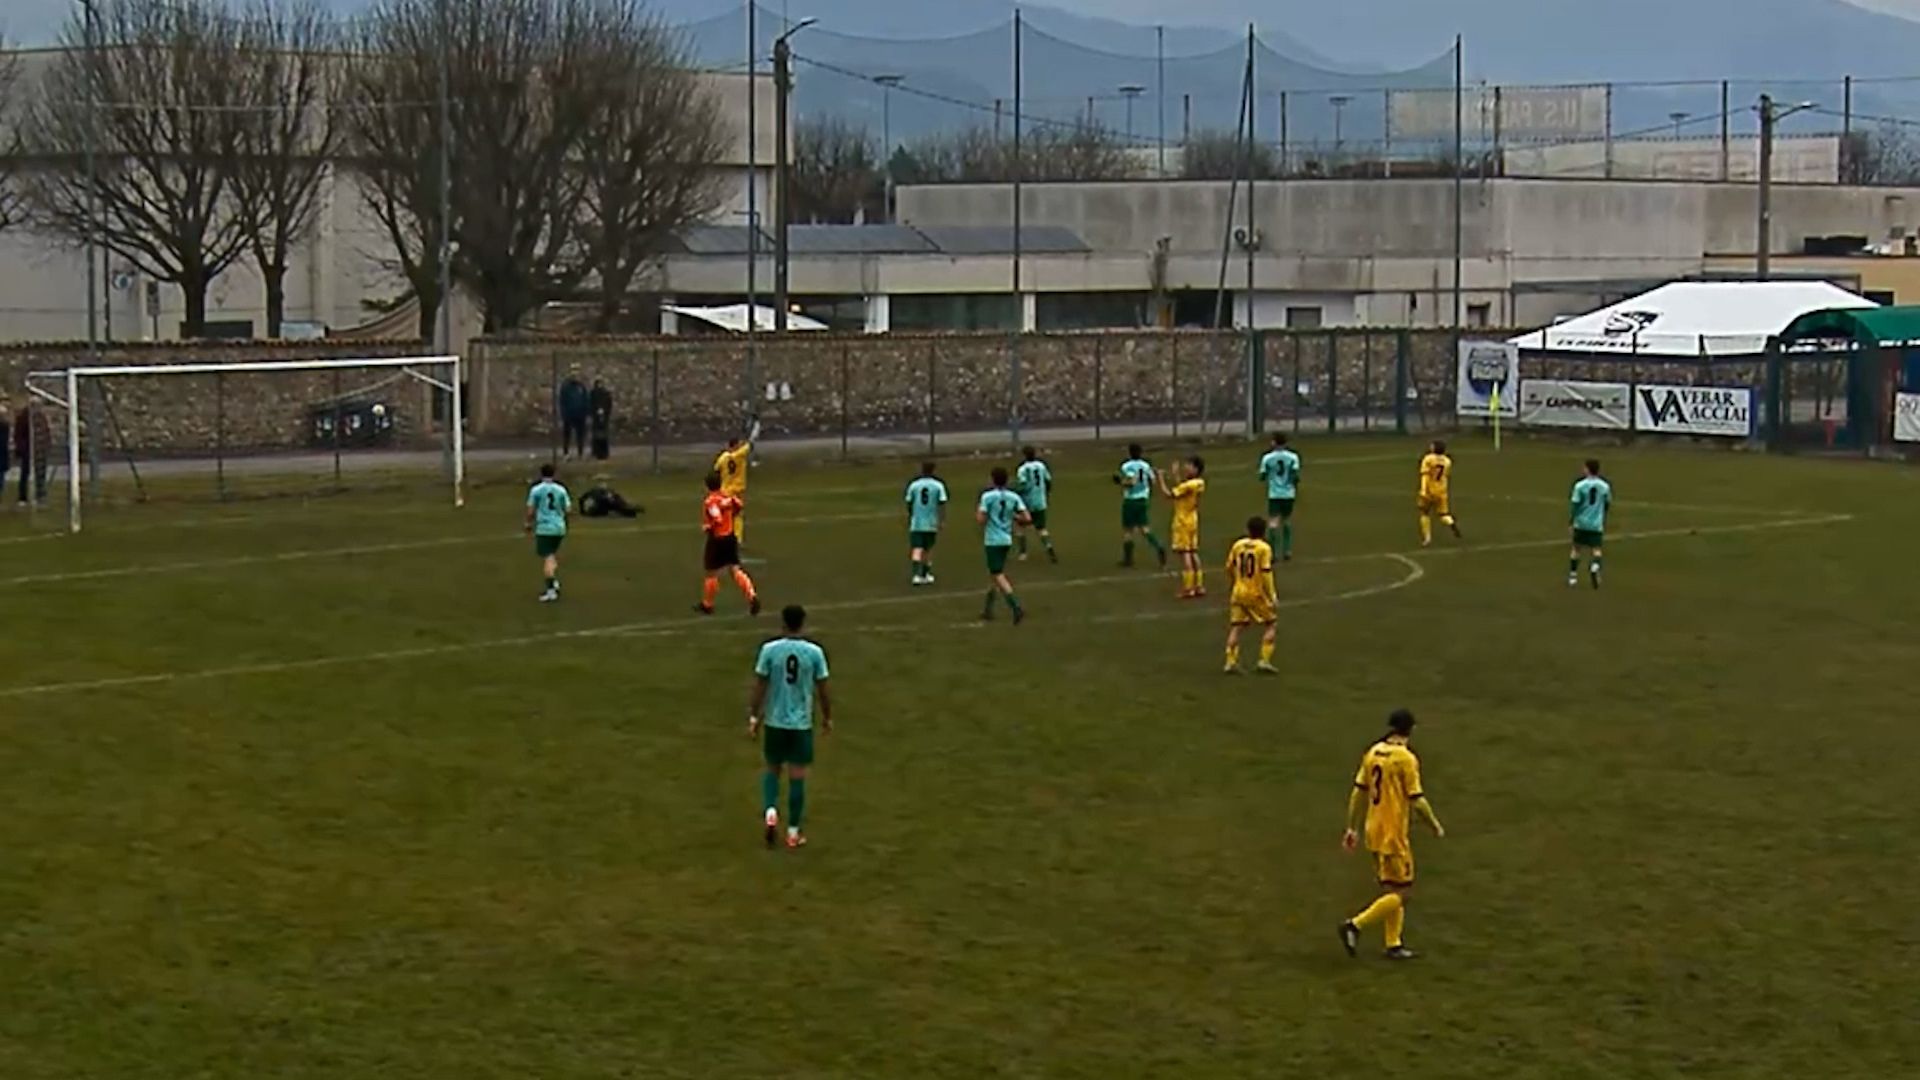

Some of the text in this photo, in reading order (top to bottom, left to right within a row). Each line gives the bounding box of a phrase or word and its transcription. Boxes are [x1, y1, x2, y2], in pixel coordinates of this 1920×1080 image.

[1690, 405, 1746, 421] ACCIAI
[1435, 464, 1444, 480] 7
[1240, 552, 1255, 578] 10
[786, 654, 799, 684] 9
[1371, 764, 1383, 806] 3
